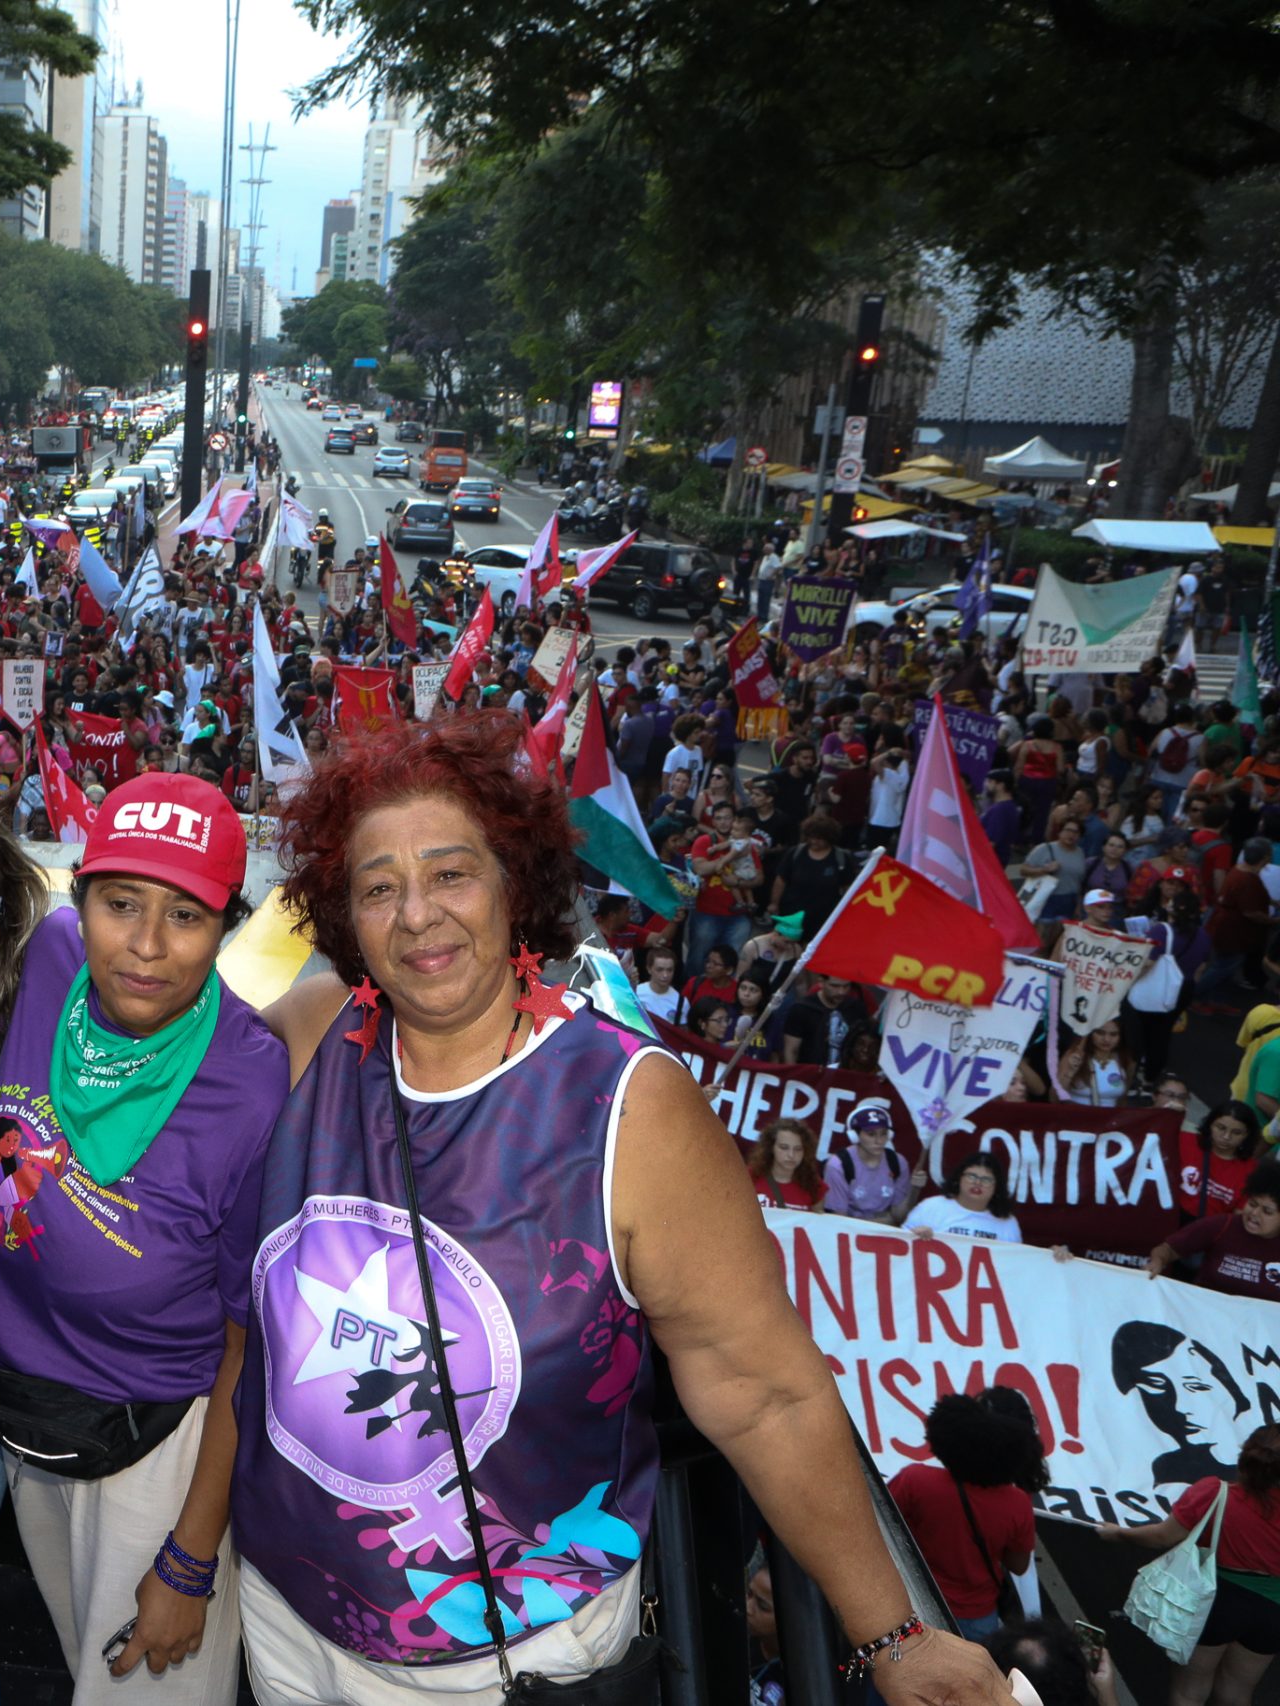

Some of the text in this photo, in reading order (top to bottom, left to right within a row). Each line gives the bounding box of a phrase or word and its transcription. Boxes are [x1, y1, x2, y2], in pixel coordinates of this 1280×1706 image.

[795, 605, 841, 627] VIVE
[107, 830, 207, 854] CENTRAL ÚNICA DOS TRABALHADORES
[113, 802, 202, 838] CUT
[200, 815, 212, 847] BRASIL
[1065, 937, 1143, 968] OCUPAÇÃO
[881, 954, 986, 1008] PCR
[994, 975, 1050, 1012] LÁS
[77, 1075, 121, 1089] @frent
[886, 1035, 1002, 1097] VIVE
[4, 1103, 17, 1114] na
[18, 1104, 40, 1126] luta
[35, 1122, 52, 1143] por
[66, 1157, 83, 1172] Fim
[928, 1118, 1174, 1210] CONTRA
[64, 1172, 121, 1223] Justiça climática
[70, 1169, 140, 1213] Justiça reprodutiva
[57, 1178, 143, 1259] Sem anistia aos golpistas
[313, 1203, 380, 1221] MULHERES
[441, 1243, 482, 1288] PAULO
[1085, 1249, 1151, 1268] MOVIMEN
[766, 1226, 1020, 1350] NTRA
[330, 1308, 398, 1367] PT
[487, 1304, 513, 1360] LUGAR
[500, 1363, 513, 1384] DE
[477, 1387, 512, 1436] MULHER
[272, 1425, 400, 1502] LUGAR DE MULHER
[399, 1456, 458, 1500] POLÍTICA
